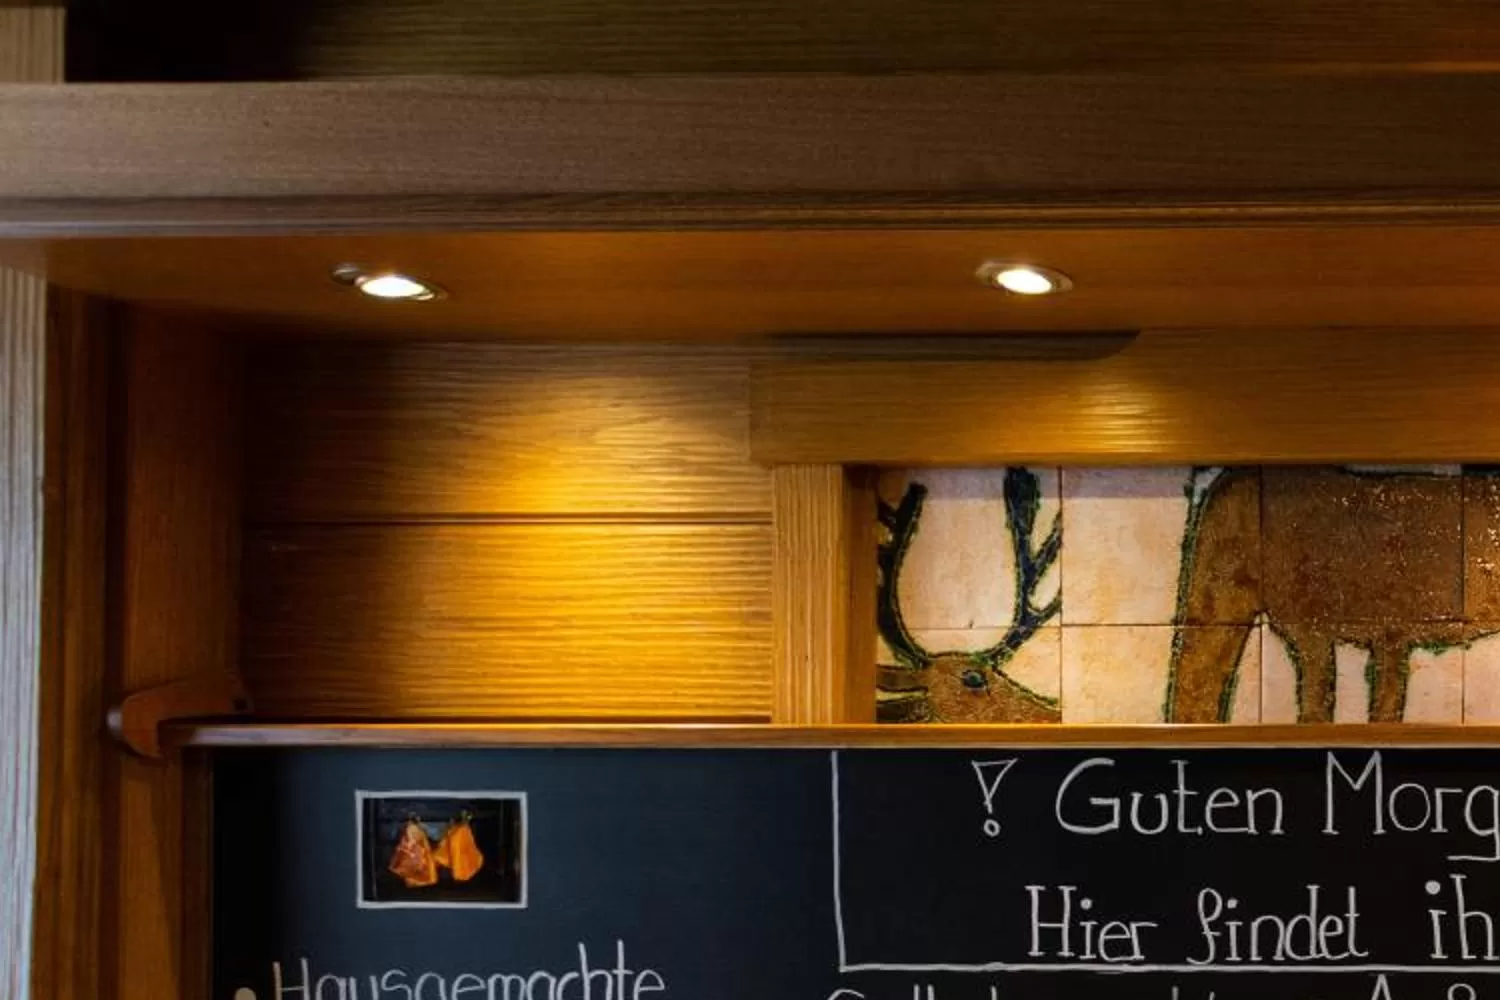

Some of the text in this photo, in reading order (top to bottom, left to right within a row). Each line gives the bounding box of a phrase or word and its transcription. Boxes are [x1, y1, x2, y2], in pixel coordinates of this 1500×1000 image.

[1055, 757, 1285, 835] Guten
[1024, 884, 1158, 961] Hier
[1186, 885, 1369, 965] findet
